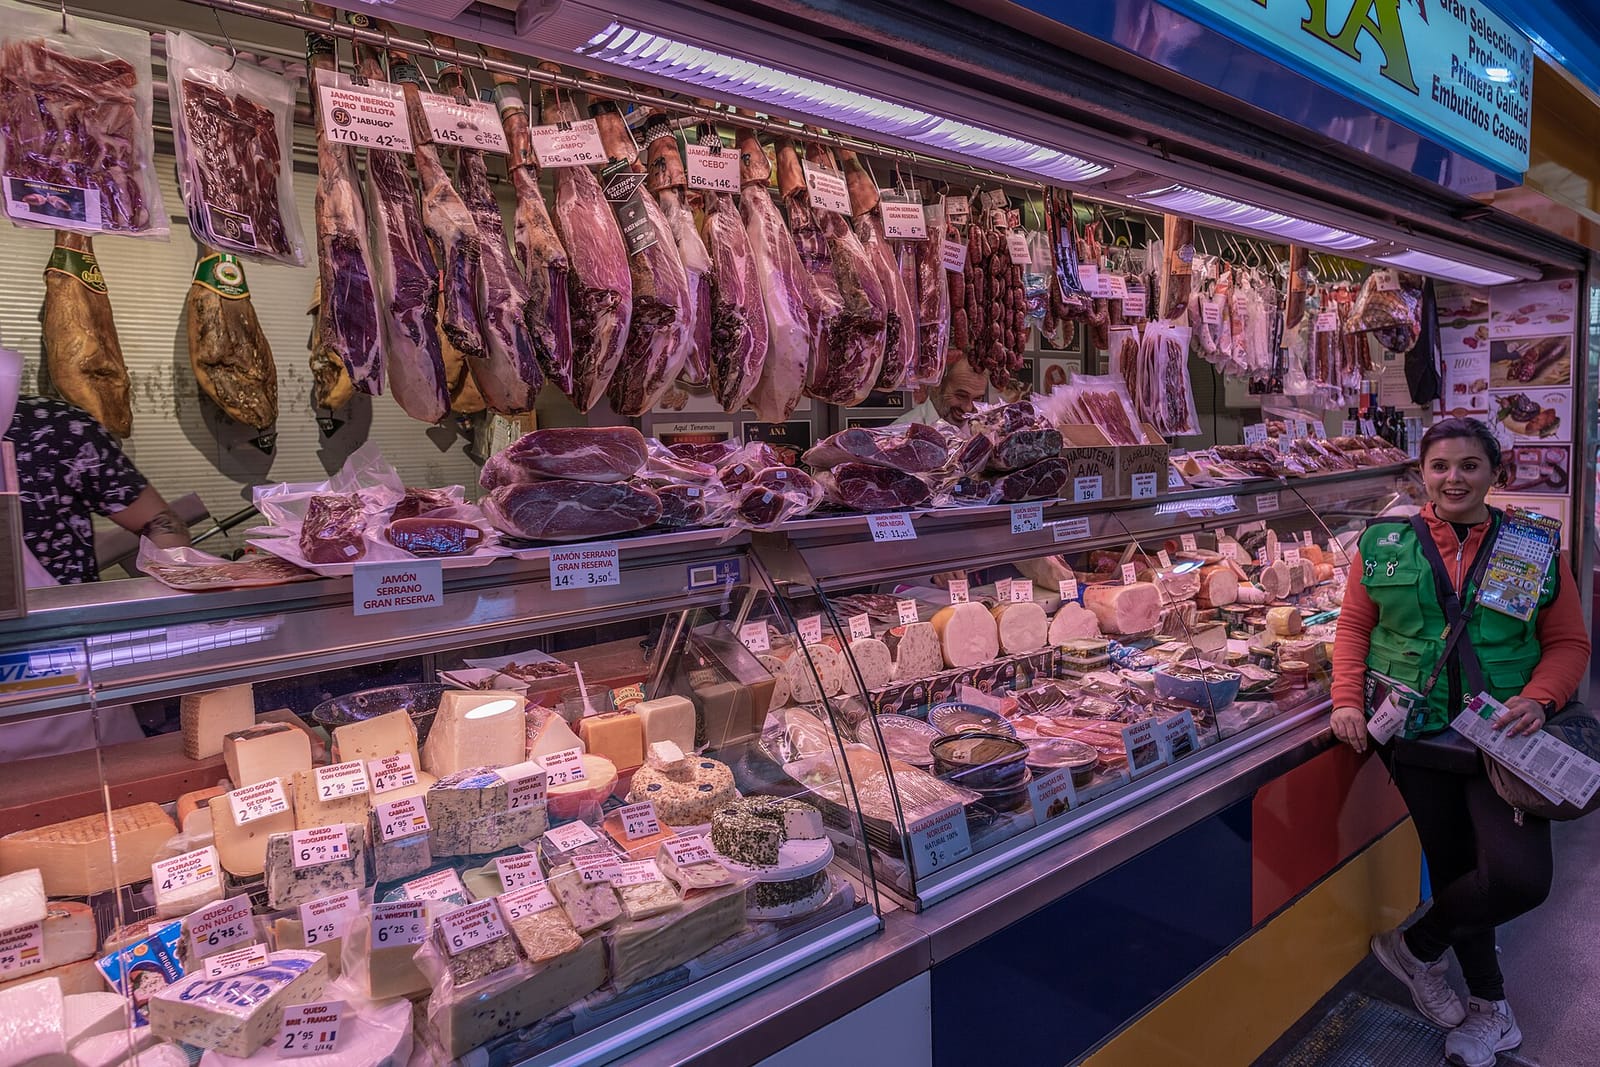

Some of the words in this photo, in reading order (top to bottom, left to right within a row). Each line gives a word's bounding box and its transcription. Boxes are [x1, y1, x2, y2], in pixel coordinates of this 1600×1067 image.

[1469, 7, 1519, 65] Selección
[1520, 50, 1530, 74] de
[1451, 54, 1493, 104] Primera
[1496, 86, 1528, 128] Calidad
[1520, 77, 1529, 101] de
[333, 100, 356, 110] PURO
[361, 105, 396, 117] BELLOTA
[1432, 74, 1489, 131] Embutidos
[1492, 113, 1528, 154] Caseros
[331, 127, 358, 142] 170
[359, 133, 369, 142] kg
[574, 152, 593, 162] 19€
[607, 175, 636, 194] ESTIRPE
[691, 175, 707, 186] 56€
[714, 178, 731, 189] 14€
[610, 182, 637, 199] NEGRA
[769, 427, 786, 435] ANA
[1078, 463, 1100, 477] ANA
[552, 551, 580, 562] JAMÓN
[582, 549, 616, 560] SERRANO
[558, 562, 580, 571] GRAN
[581, 560, 613, 569] RESERVA
[381, 572, 417, 585] JAMÓN
[377, 584, 422, 597] SERRANO
[364, 599, 392, 609] GRAN
[395, 594, 436, 606] RESERVA
[1133, 733, 1152, 744] MARUCA
[382, 756, 400, 765] QUESO
[546, 754, 562, 762] QUESO
[564, 751, 575, 759] BOLA
[319, 766, 339, 775] QUESO
[340, 762, 361, 771] GOUDA
[547, 760, 562, 768] TIERNO
[321, 773, 334, 781] CON
[335, 768, 362, 778] COMINOS
[375, 765, 411, 778] AMSTERDAM
[1057, 773, 1065, 781] DEL
[233, 788, 254, 798] QUESO
[255, 781, 278, 793] GOUDA
[240, 788, 275, 803] SOMBRERO
[513, 785, 529, 793] QUESO
[257, 796, 273, 805] COPA
[391, 800, 411, 809] QUESO
[388, 806, 416, 817] CABRALES
[935, 807, 962, 824] AHUMADO
[309, 828, 331, 837] QUESO
[927, 823, 953, 839] NORUEGO
[925, 837, 945, 851] NATURAL
[946, 831, 958, 842] 100%
[158, 859, 179, 869] QUESO
[188, 850, 208, 859] CABRA
[500, 857, 515, 865] QUESO
[930, 851, 938, 866] 3
[939, 851, 945, 860] €
[168, 858, 202, 873] CURADO
[177, 864, 202, 874] MALAGA
[310, 902, 329, 911] QUESO
[330, 895, 349, 904] GOUDA
[326, 903, 347, 913] NUECES
[396, 902, 423, 910] CHEDDAR
[203, 904, 234, 921] QUESO
[384, 911, 413, 920] WHISKEY
[446, 911, 465, 922] QUESO
[465, 903, 491, 915] CHEDDAR
[465, 911, 490, 922] CERVEZA
[192, 923, 212, 935] CON
[214, 908, 248, 927] NUECES
[237, 923, 244, 931] €
[462, 920, 480, 930] NEGRA
[486, 922, 496, 931] €
[14, 923, 38, 934] CABRA
[411, 924, 420, 934] €
[158, 951, 178, 981] ORIGINAL
[303, 1006, 327, 1015] QUESO
[286, 1018, 302, 1026] BRIE
[306, 1014, 338, 1024] FRANCES
